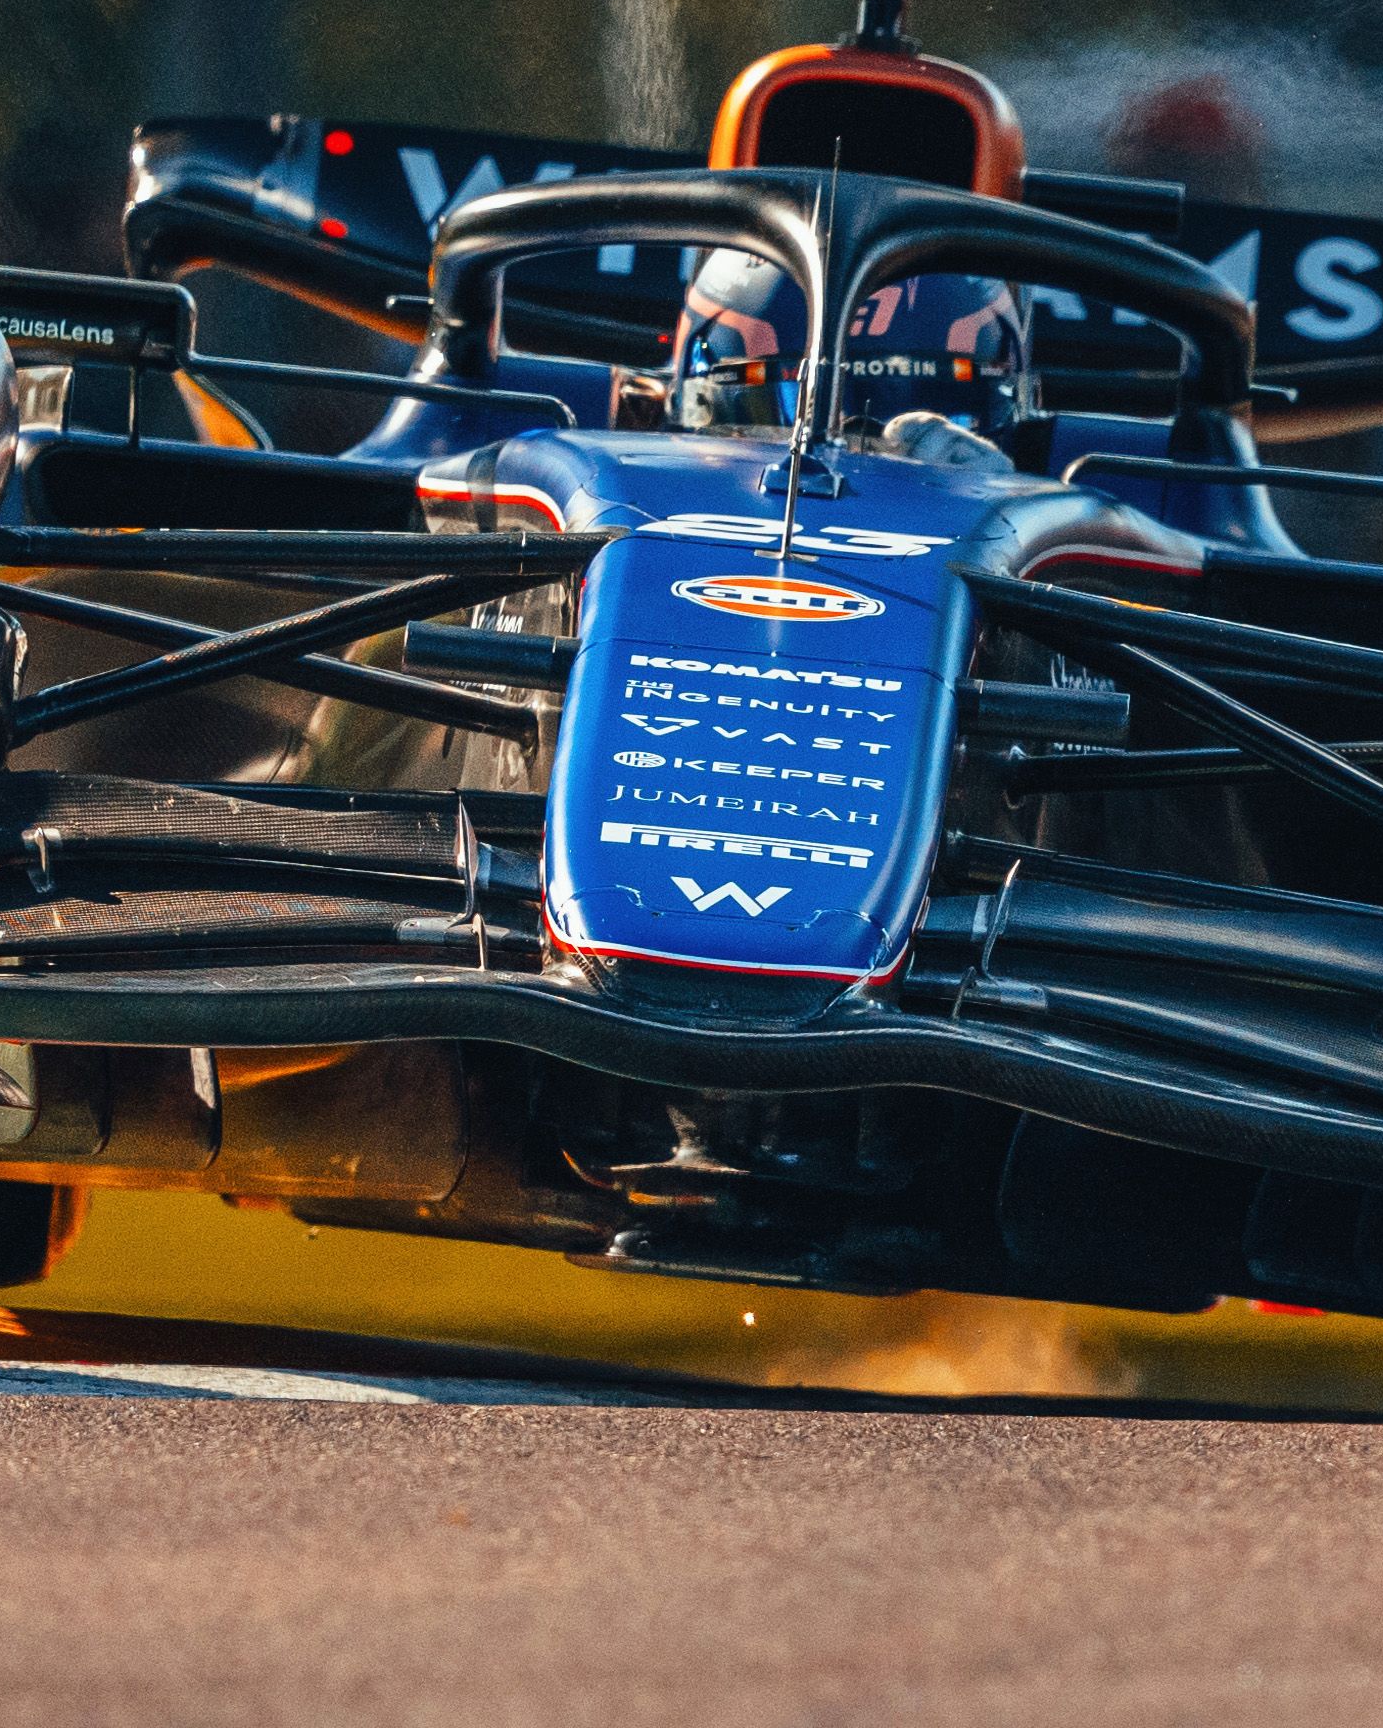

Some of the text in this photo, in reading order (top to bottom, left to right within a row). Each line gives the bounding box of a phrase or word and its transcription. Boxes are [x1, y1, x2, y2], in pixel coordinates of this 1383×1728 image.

[635, 512, 955, 557] 23
[684, 585, 870, 612] Gulf
[630, 654, 903, 692] KOMATSU
[624, 686, 897, 723] INGENUITY
[712, 725, 892, 755] VAST
[673, 757, 886, 791] KEEPER
[607, 783, 880, 826] JUMEIRAH
[599, 821, 875, 869] PIRELLI
